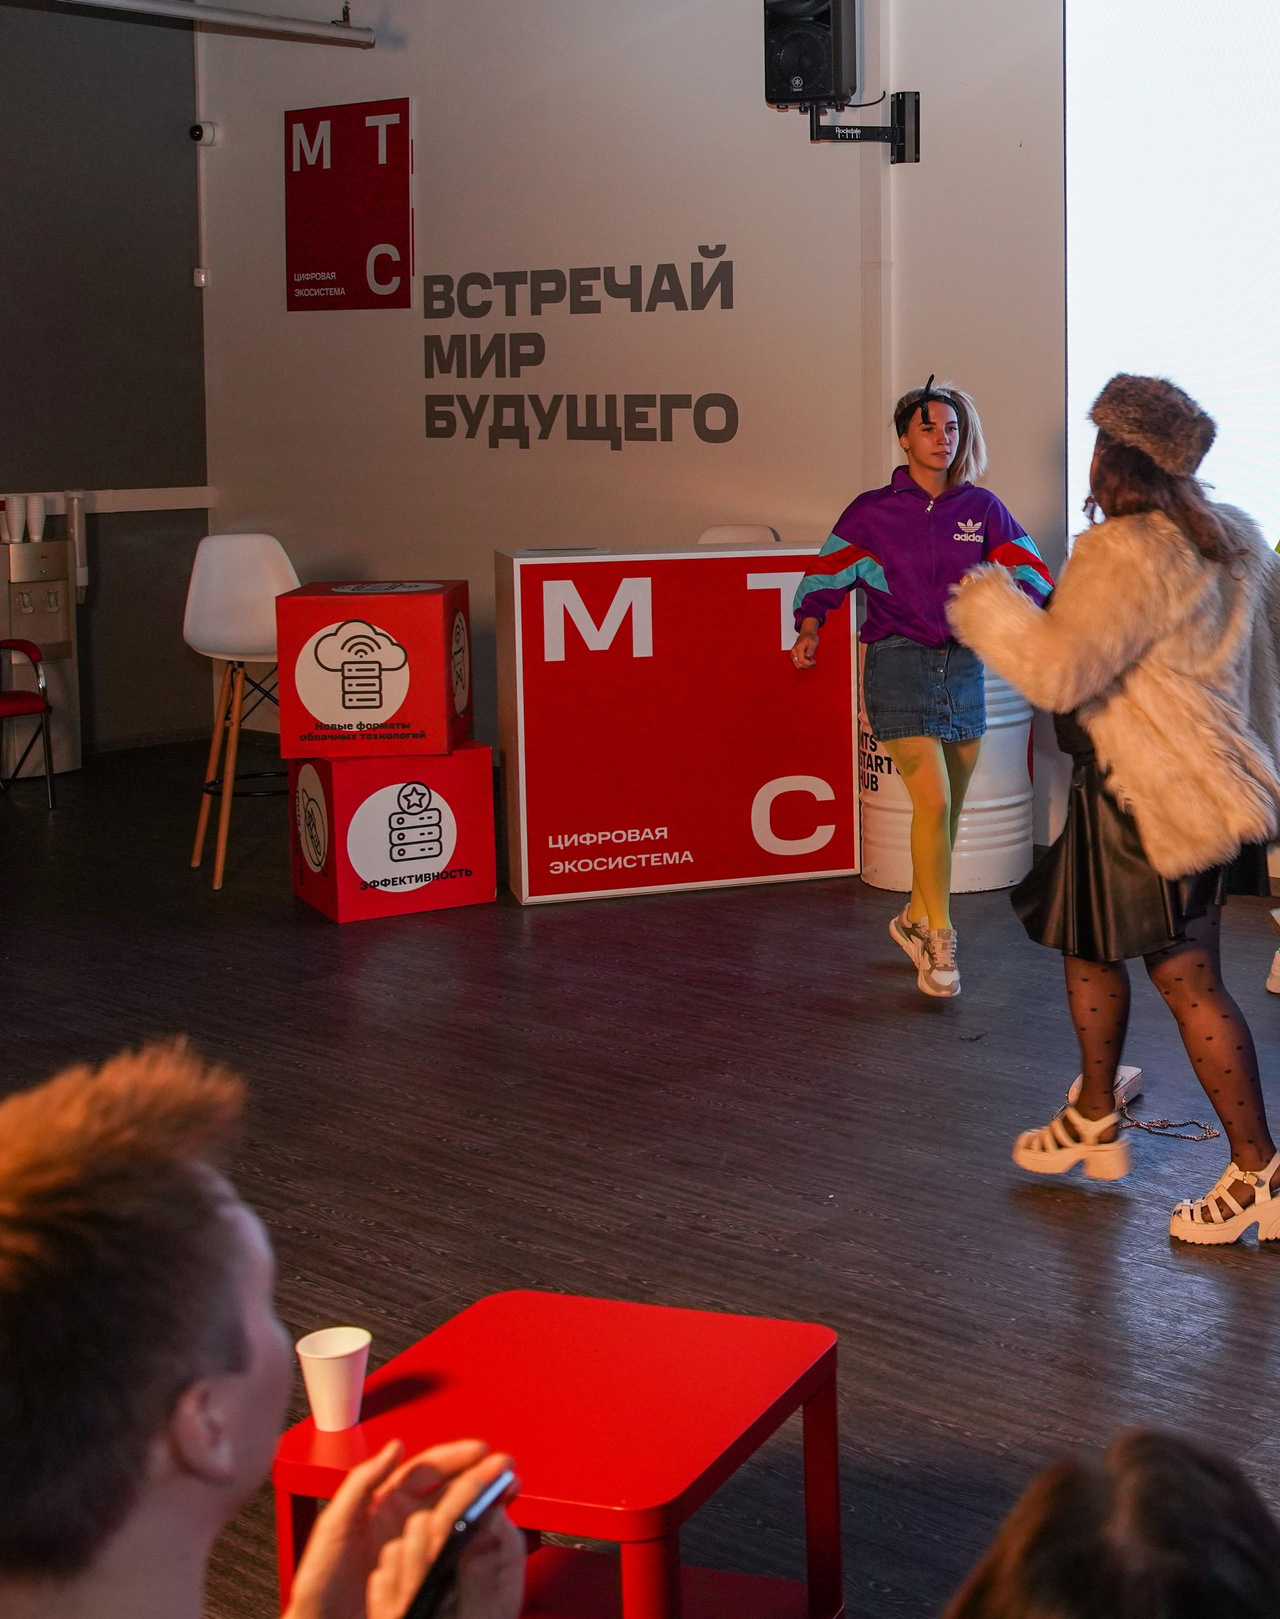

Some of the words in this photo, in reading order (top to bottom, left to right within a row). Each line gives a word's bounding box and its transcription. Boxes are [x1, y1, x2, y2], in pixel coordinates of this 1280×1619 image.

[294, 271, 337, 282] ЦИФРОВАЯ
[423, 244, 734, 319] ВСТРЕЧАЙ
[294, 287, 346, 297] ЭКОСИСТЕМА
[424, 332, 546, 379] МИР
[425, 393, 739, 451] БУДУЩЕГО
[953, 533, 984, 543] adidas
[542, 577, 653, 662] М
[299, 732, 357, 742] облачных
[360, 730, 426, 740] технологий
[314, 722, 354, 731] Новые
[356, 720, 411, 732] форматы
[860, 750, 901, 775] TART
[751, 775, 836, 856] С
[548, 826, 669, 850] ЦИФРОВАЯ
[549, 850, 695, 875] ЭКОСИСТЕМА
[360, 867, 474, 891] ЭФФЕКТИВНОСТЬ
